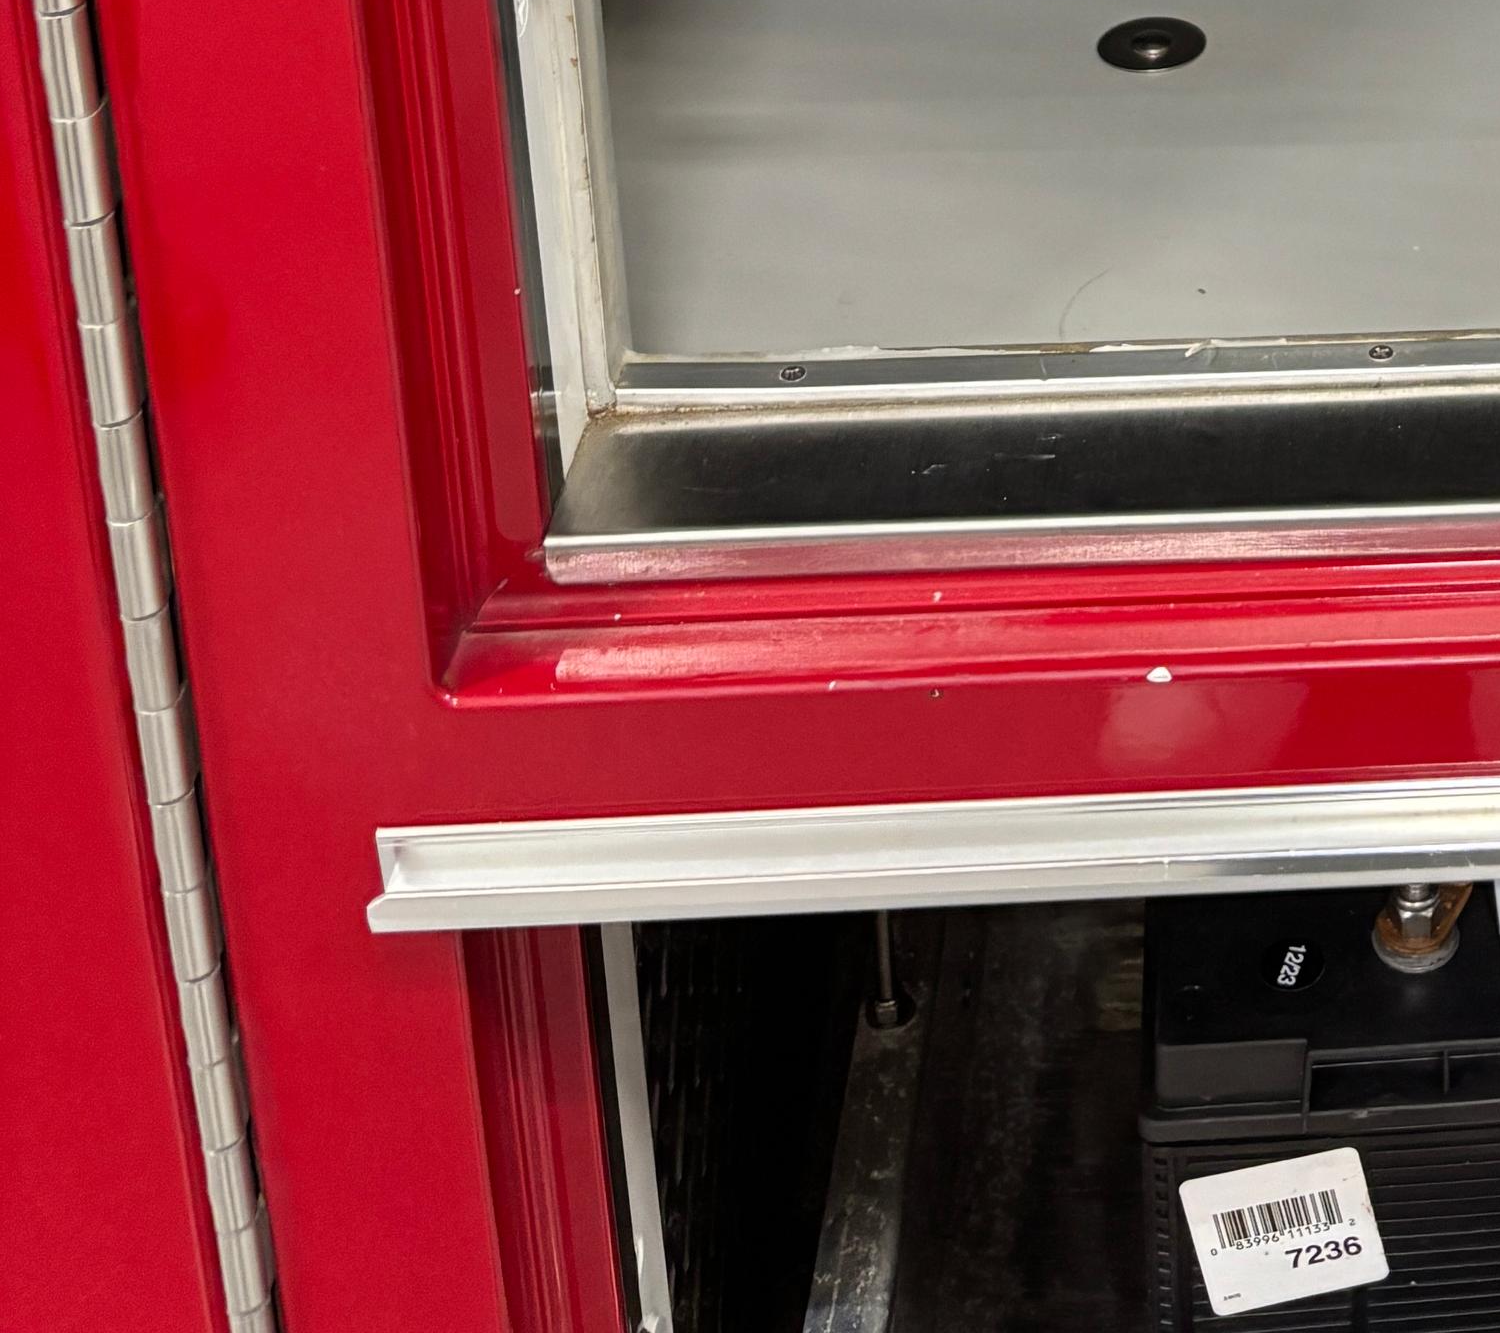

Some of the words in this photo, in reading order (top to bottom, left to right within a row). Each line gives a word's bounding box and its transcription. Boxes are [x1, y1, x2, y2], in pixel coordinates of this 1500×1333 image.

[1277, 944, 1307, 986] 12/23
[1210, 1248, 1218, 1256] 0
[1235, 1234, 1280, 1251] 83996
[1288, 1221, 1331, 1239] 11133
[1348, 1218, 1356, 1227] 2
[1285, 1236, 1362, 1269] 7236
